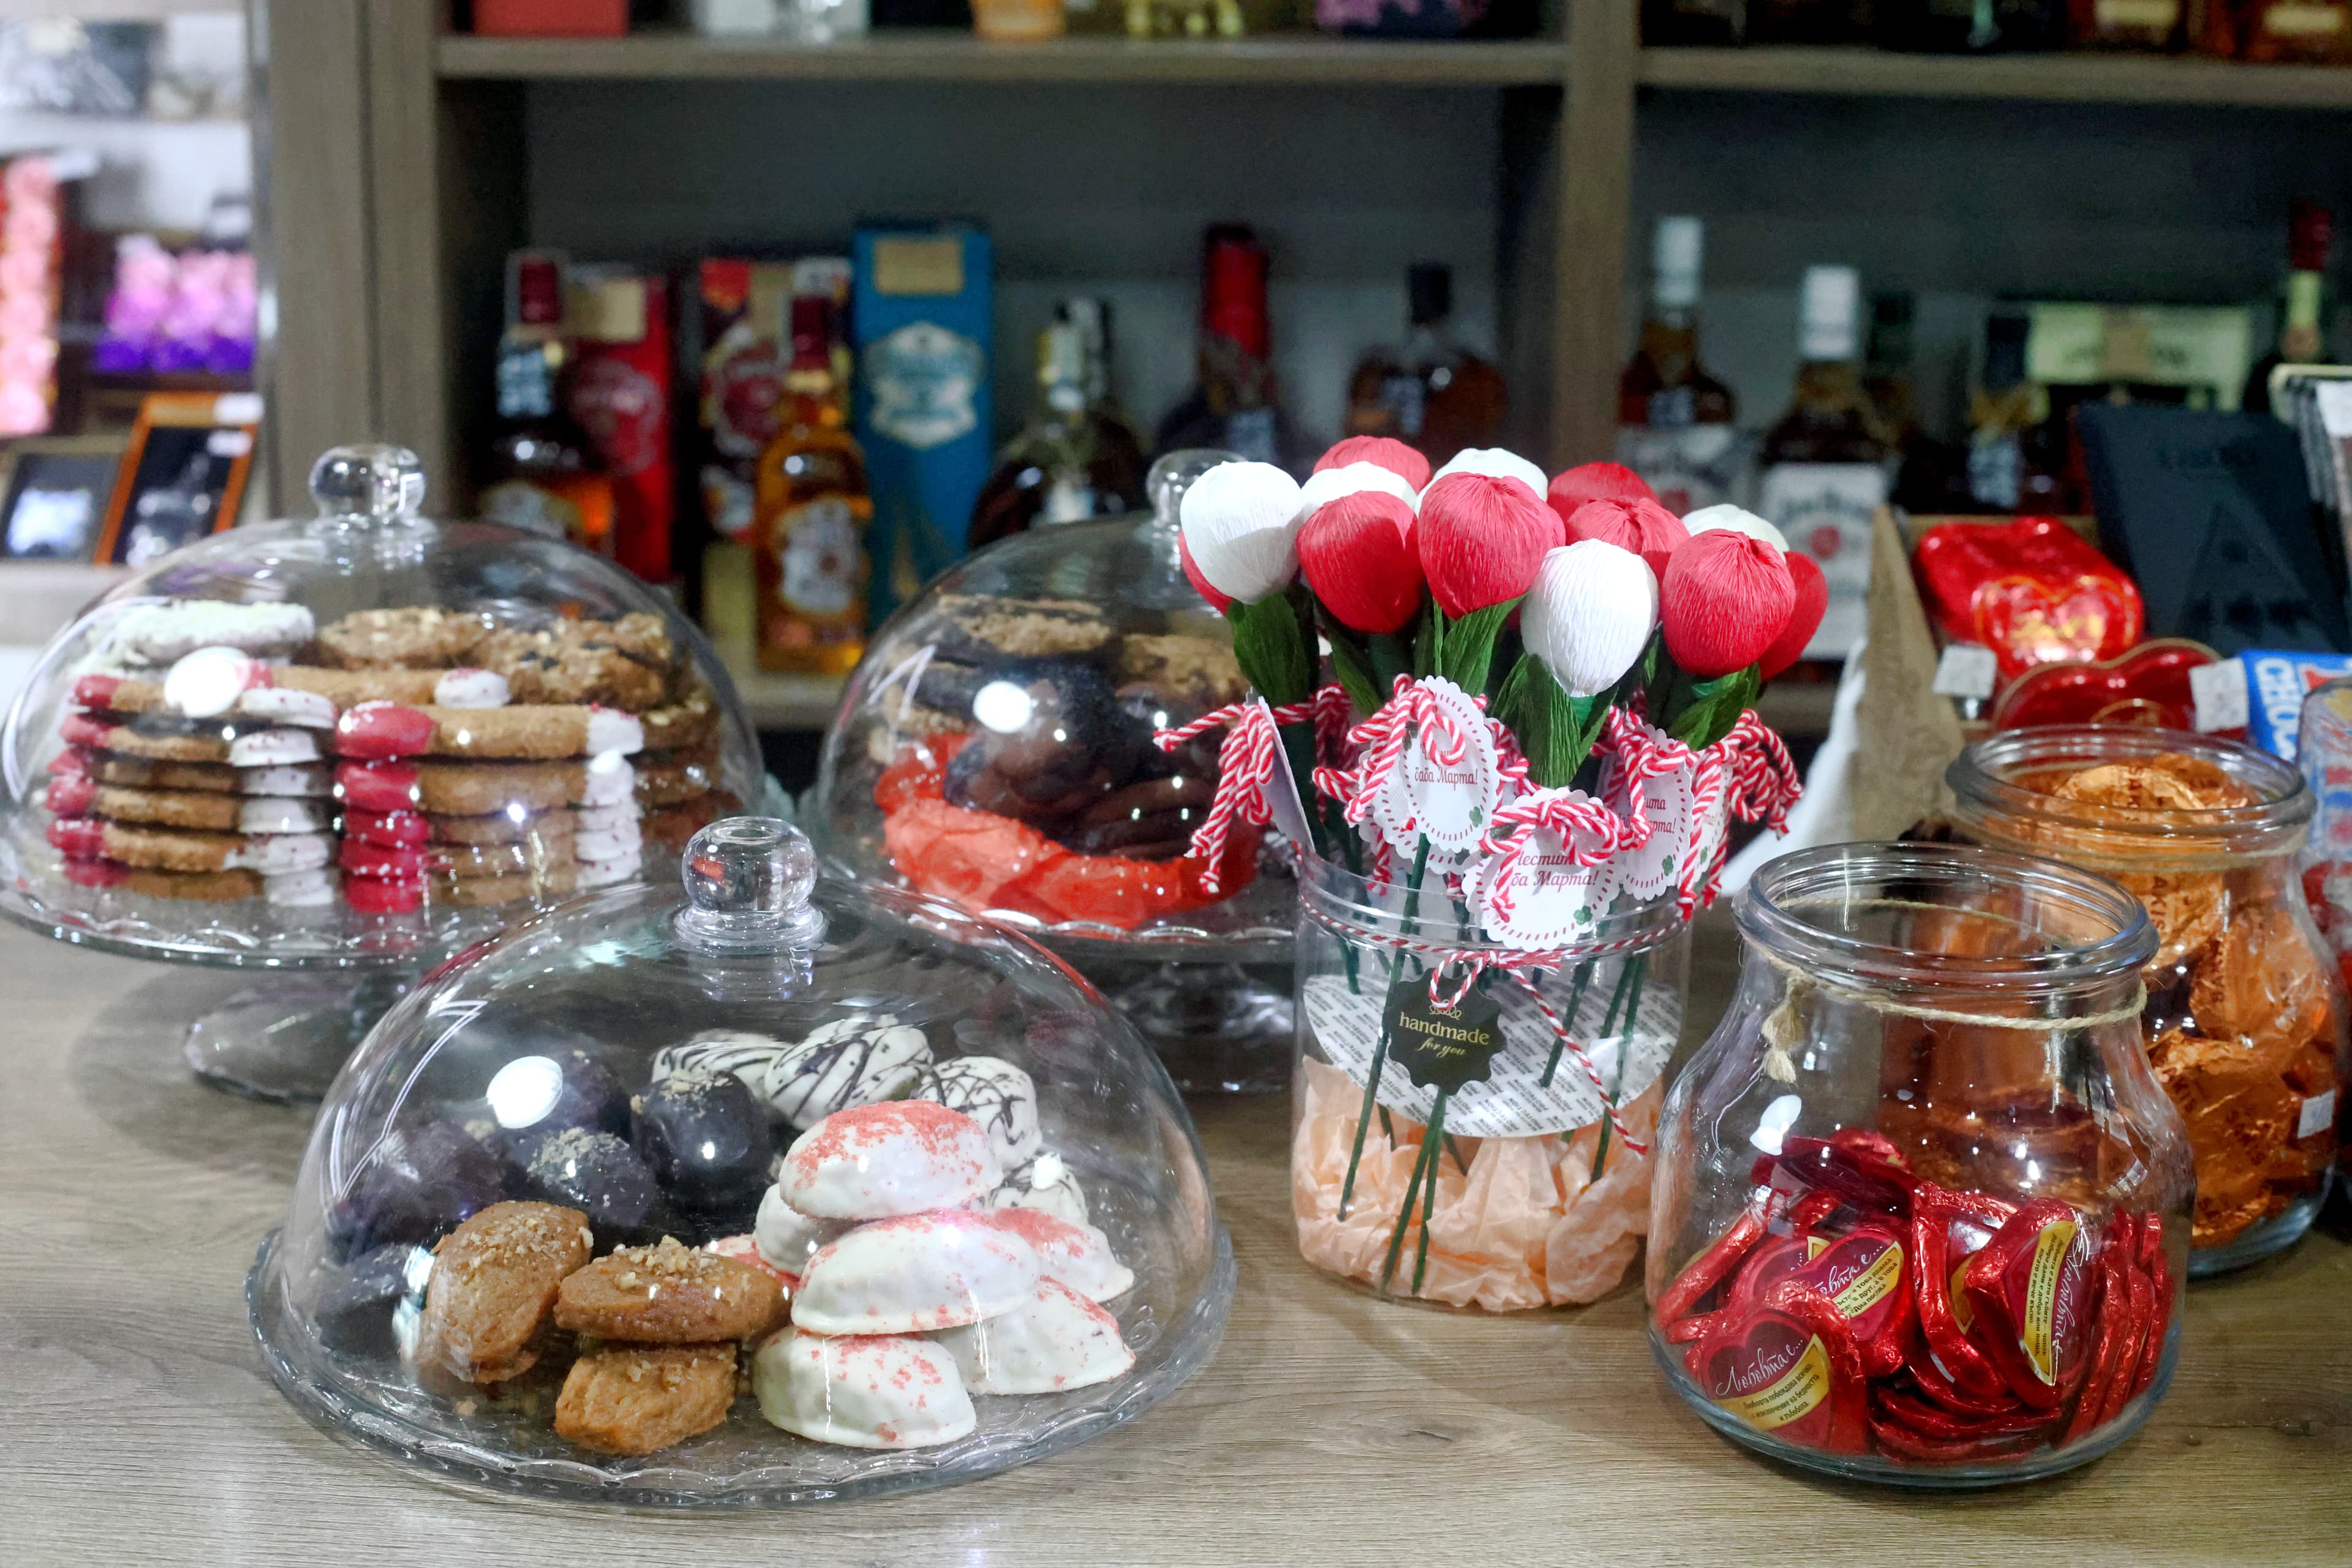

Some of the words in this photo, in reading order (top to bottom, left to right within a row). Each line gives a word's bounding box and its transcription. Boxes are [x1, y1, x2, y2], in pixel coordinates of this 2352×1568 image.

[1414, 767, 1434, 782] баба
[1438, 767, 1478, 791] Марта!
[1517, 851, 1575, 865] естит
[1534, 870, 1600, 892] Марта!
[1399, 1012, 1490, 1045] handmade
[1415, 1037, 1441, 1051] for
[1437, 1045, 1466, 1058] you
[1883, 1263, 1898, 1276] това
[2034, 1248, 2045, 1272] когато
[1867, 1284, 1887, 1303] посока
[1716, 1348, 1789, 1396] Любовта
